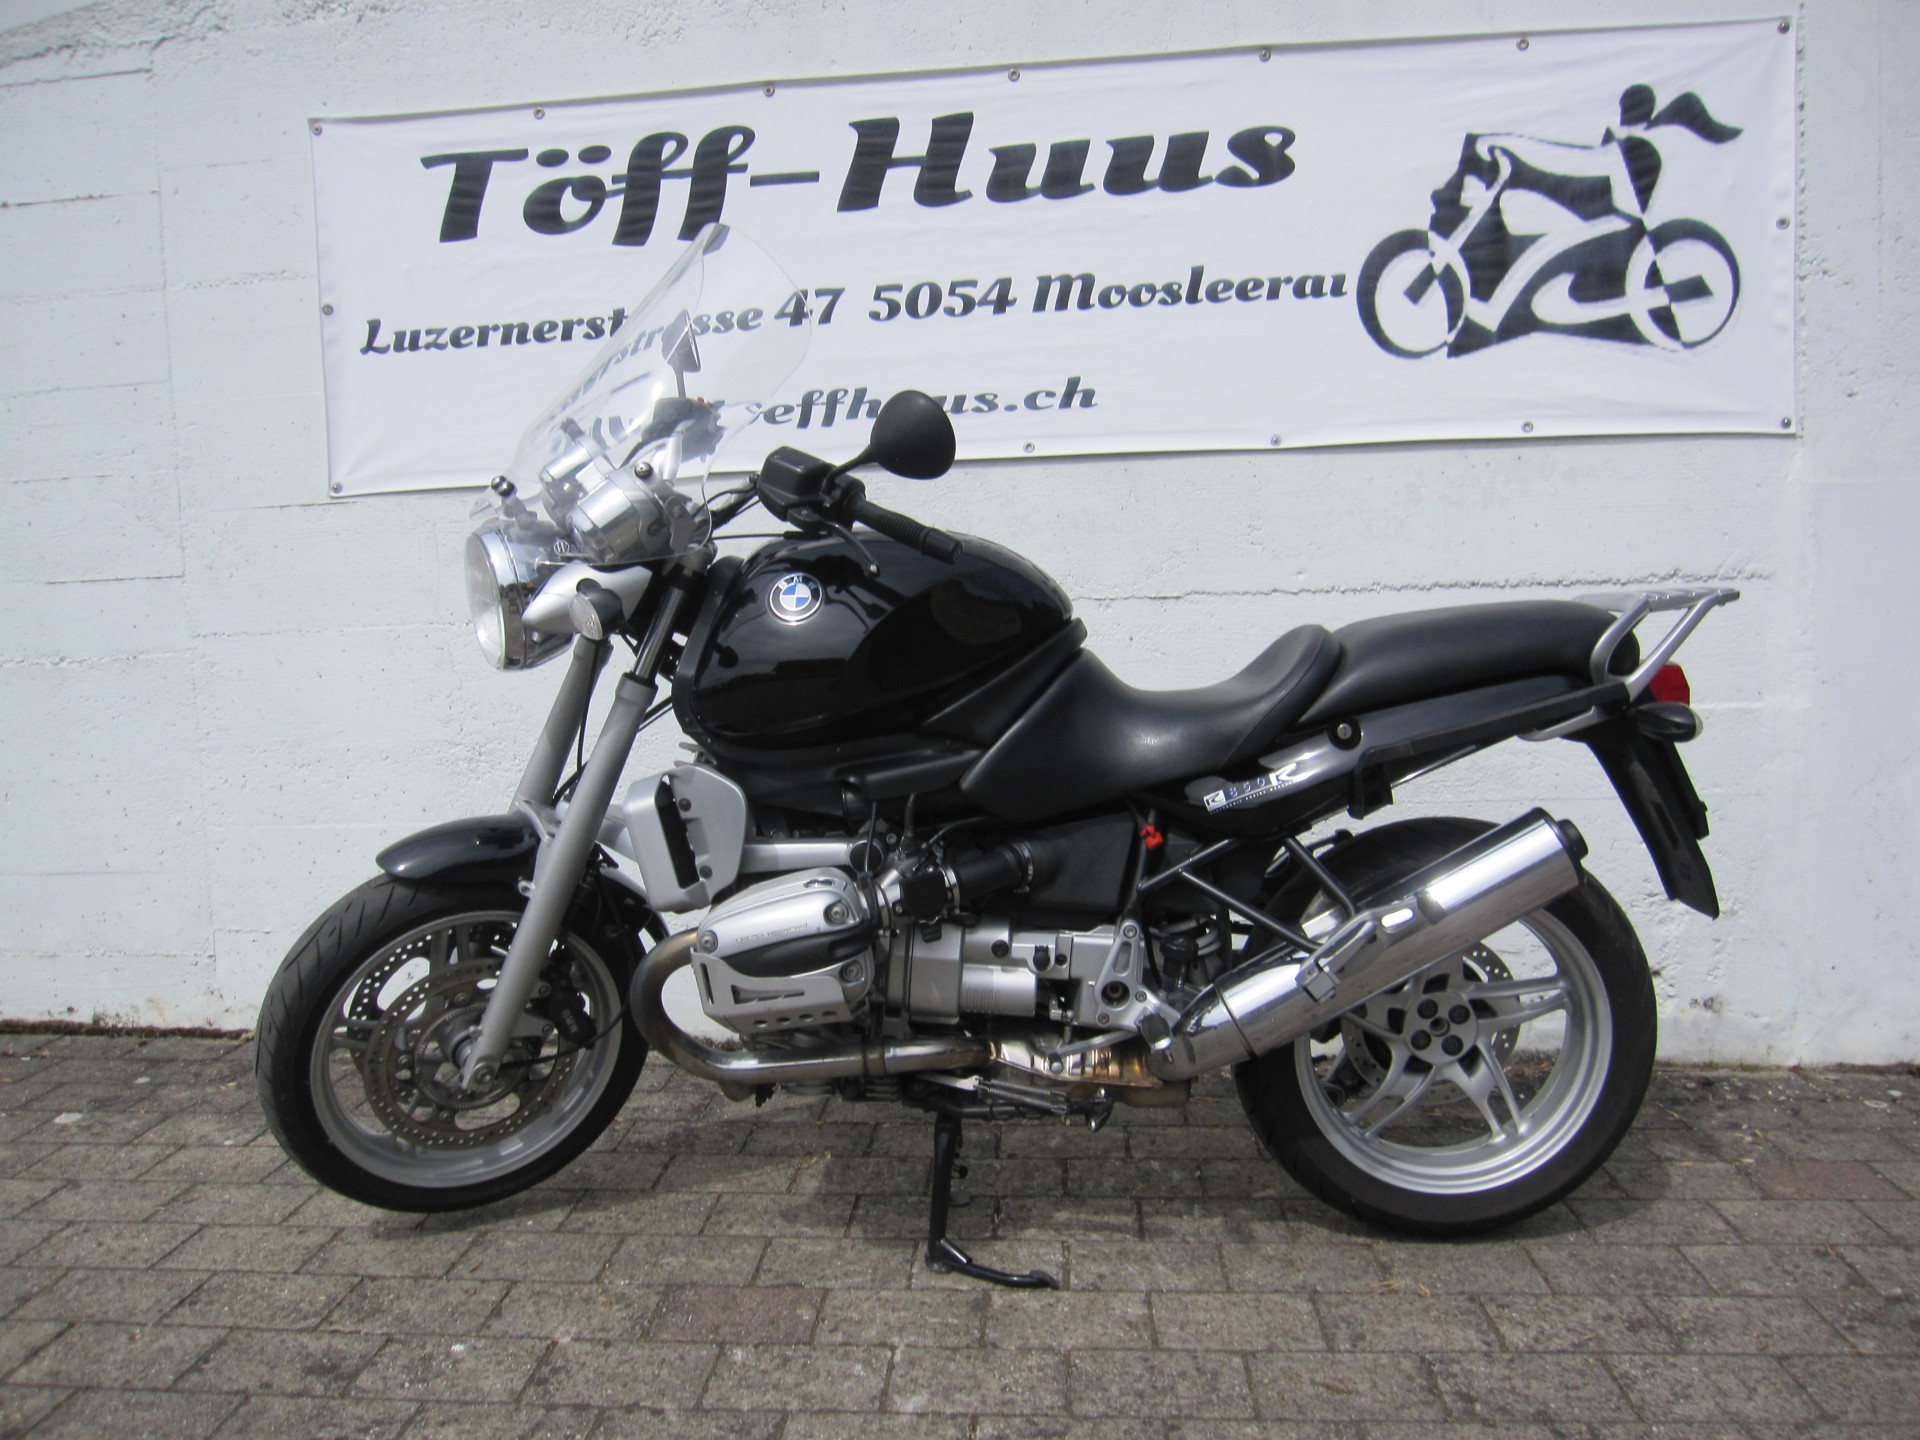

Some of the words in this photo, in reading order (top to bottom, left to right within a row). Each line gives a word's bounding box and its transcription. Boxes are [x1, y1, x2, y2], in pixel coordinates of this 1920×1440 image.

[420, 111, 1296, 247] Töff-Huus
[360, 307, 764, 355] Luzernerstsse
[774, 287, 846, 327] 47
[868, 277, 1018, 322] 5054
[1228, 776, 1266, 798] 850
